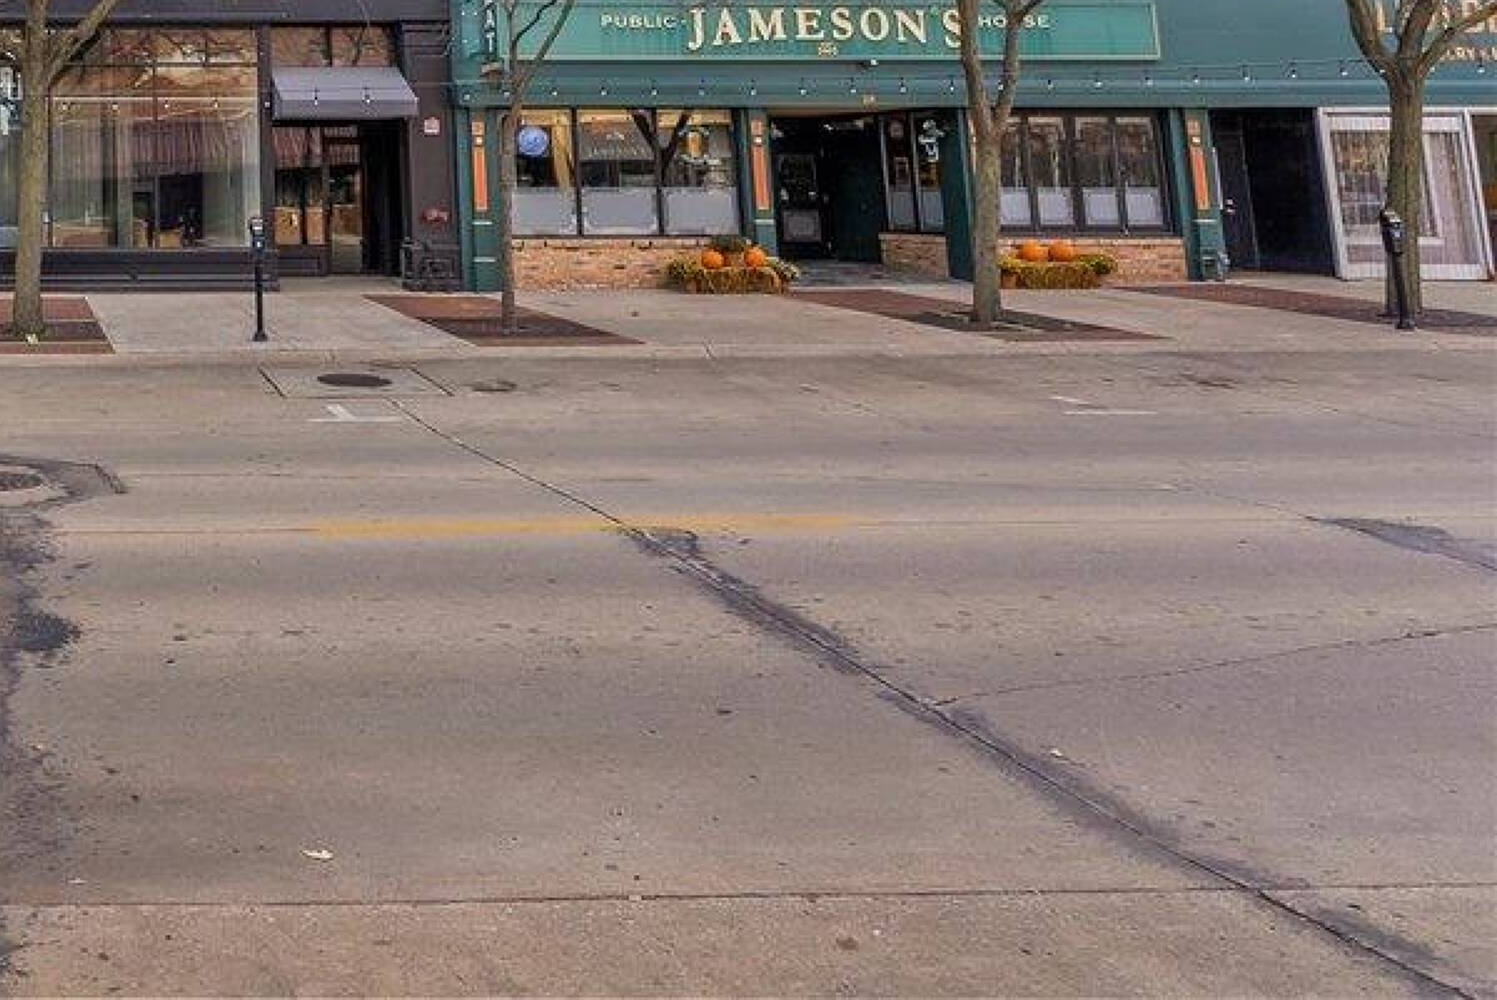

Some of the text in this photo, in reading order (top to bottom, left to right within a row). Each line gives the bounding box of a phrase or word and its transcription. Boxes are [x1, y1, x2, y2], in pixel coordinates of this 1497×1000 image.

[601, 13, 677, 29] PUBLIC
[686, 6, 963, 51] JAMESON'S
[977, 14, 1051, 29] HOSE
